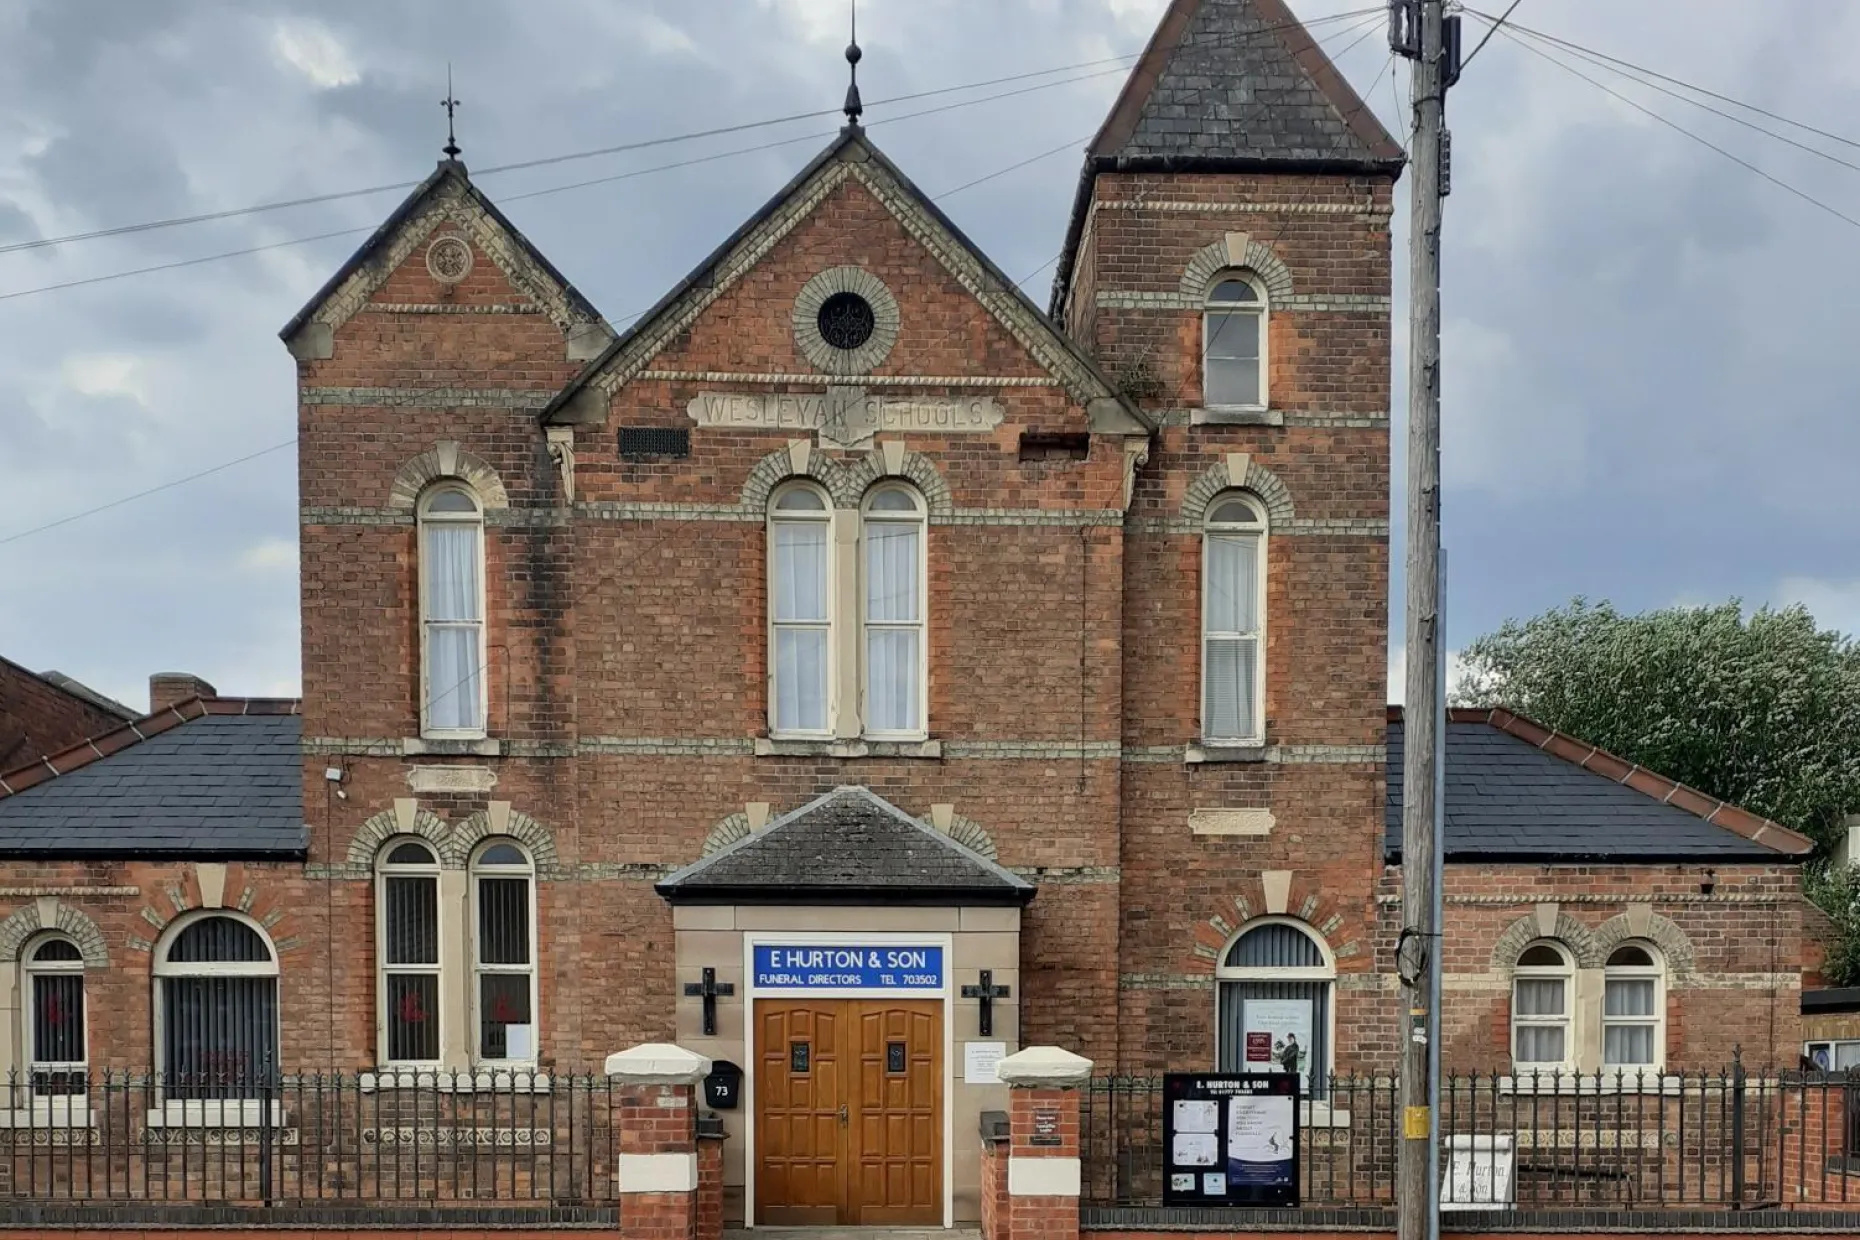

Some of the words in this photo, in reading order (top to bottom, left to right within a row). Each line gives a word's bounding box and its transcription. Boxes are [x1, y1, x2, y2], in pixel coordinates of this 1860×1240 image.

[703, 396, 847, 428] WESLEYAN
[771, 951, 781, 968] E
[786, 951, 864, 969] HURTON
[868, 951, 882, 969] &
[887, 951, 926, 969] SON
[759, 974, 804, 985] FUNERAL
[808, 974, 862, 985] DIRECTORS
[880, 974, 897, 985] TEL
[903, 974, 937, 985] 703502
[1206, 1080, 1240, 1089] HURTON
[1252, 1080, 1269, 1089] SON
[715, 1086, 728, 1096] 73
